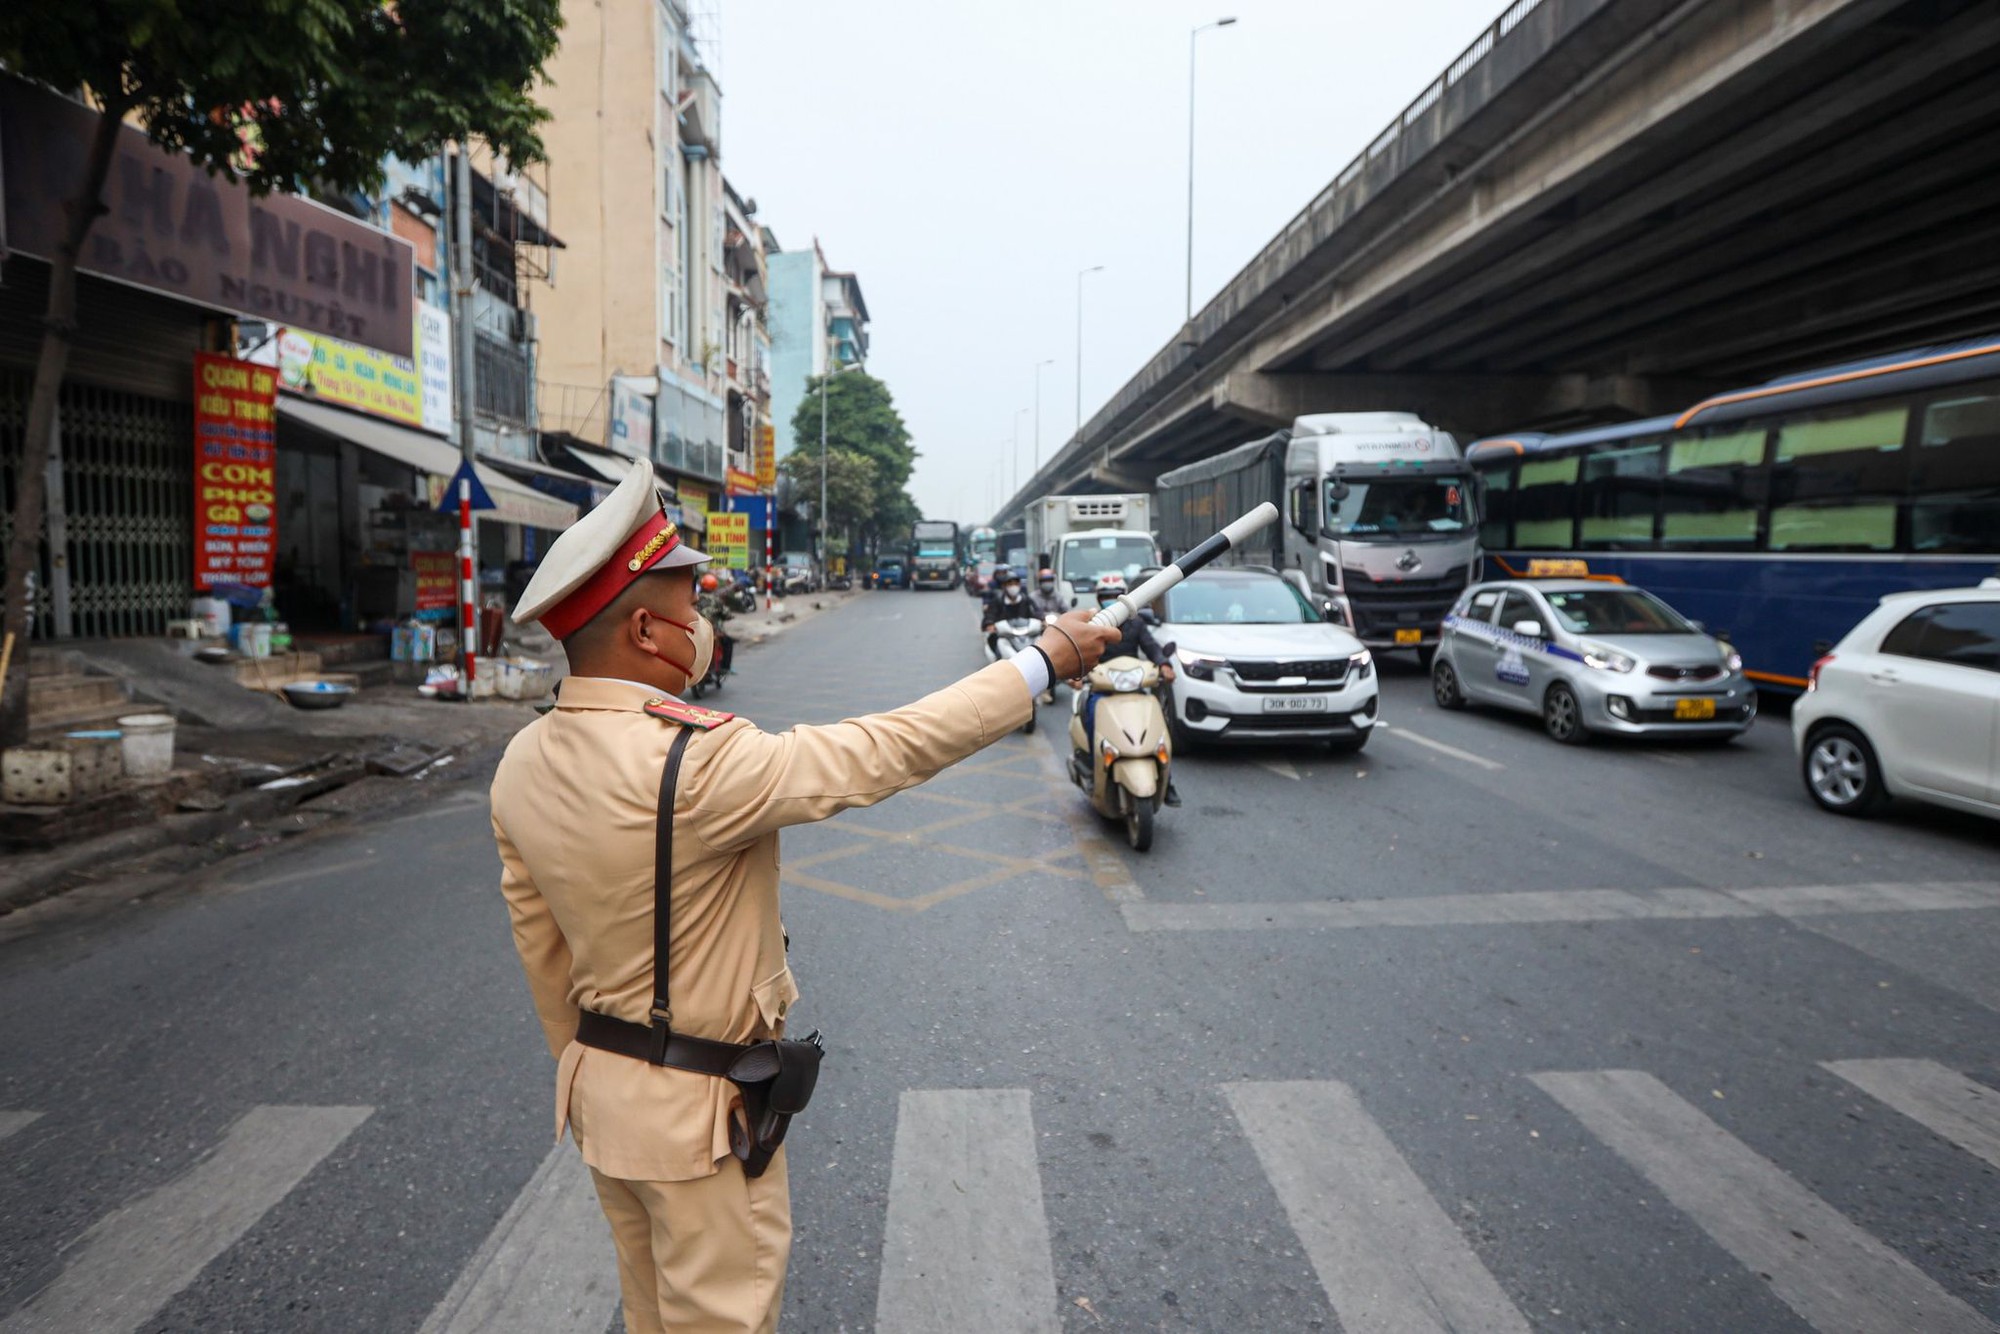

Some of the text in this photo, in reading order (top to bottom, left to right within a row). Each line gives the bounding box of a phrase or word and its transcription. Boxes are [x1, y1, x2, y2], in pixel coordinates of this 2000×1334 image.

[251, 206, 399, 312] NGHỈ
[219, 272, 368, 338] NGUYỆT
[203, 363, 248, 392] QUÁN
[201, 462, 272, 487] CƠM
[207, 502, 241, 523] GÀ
